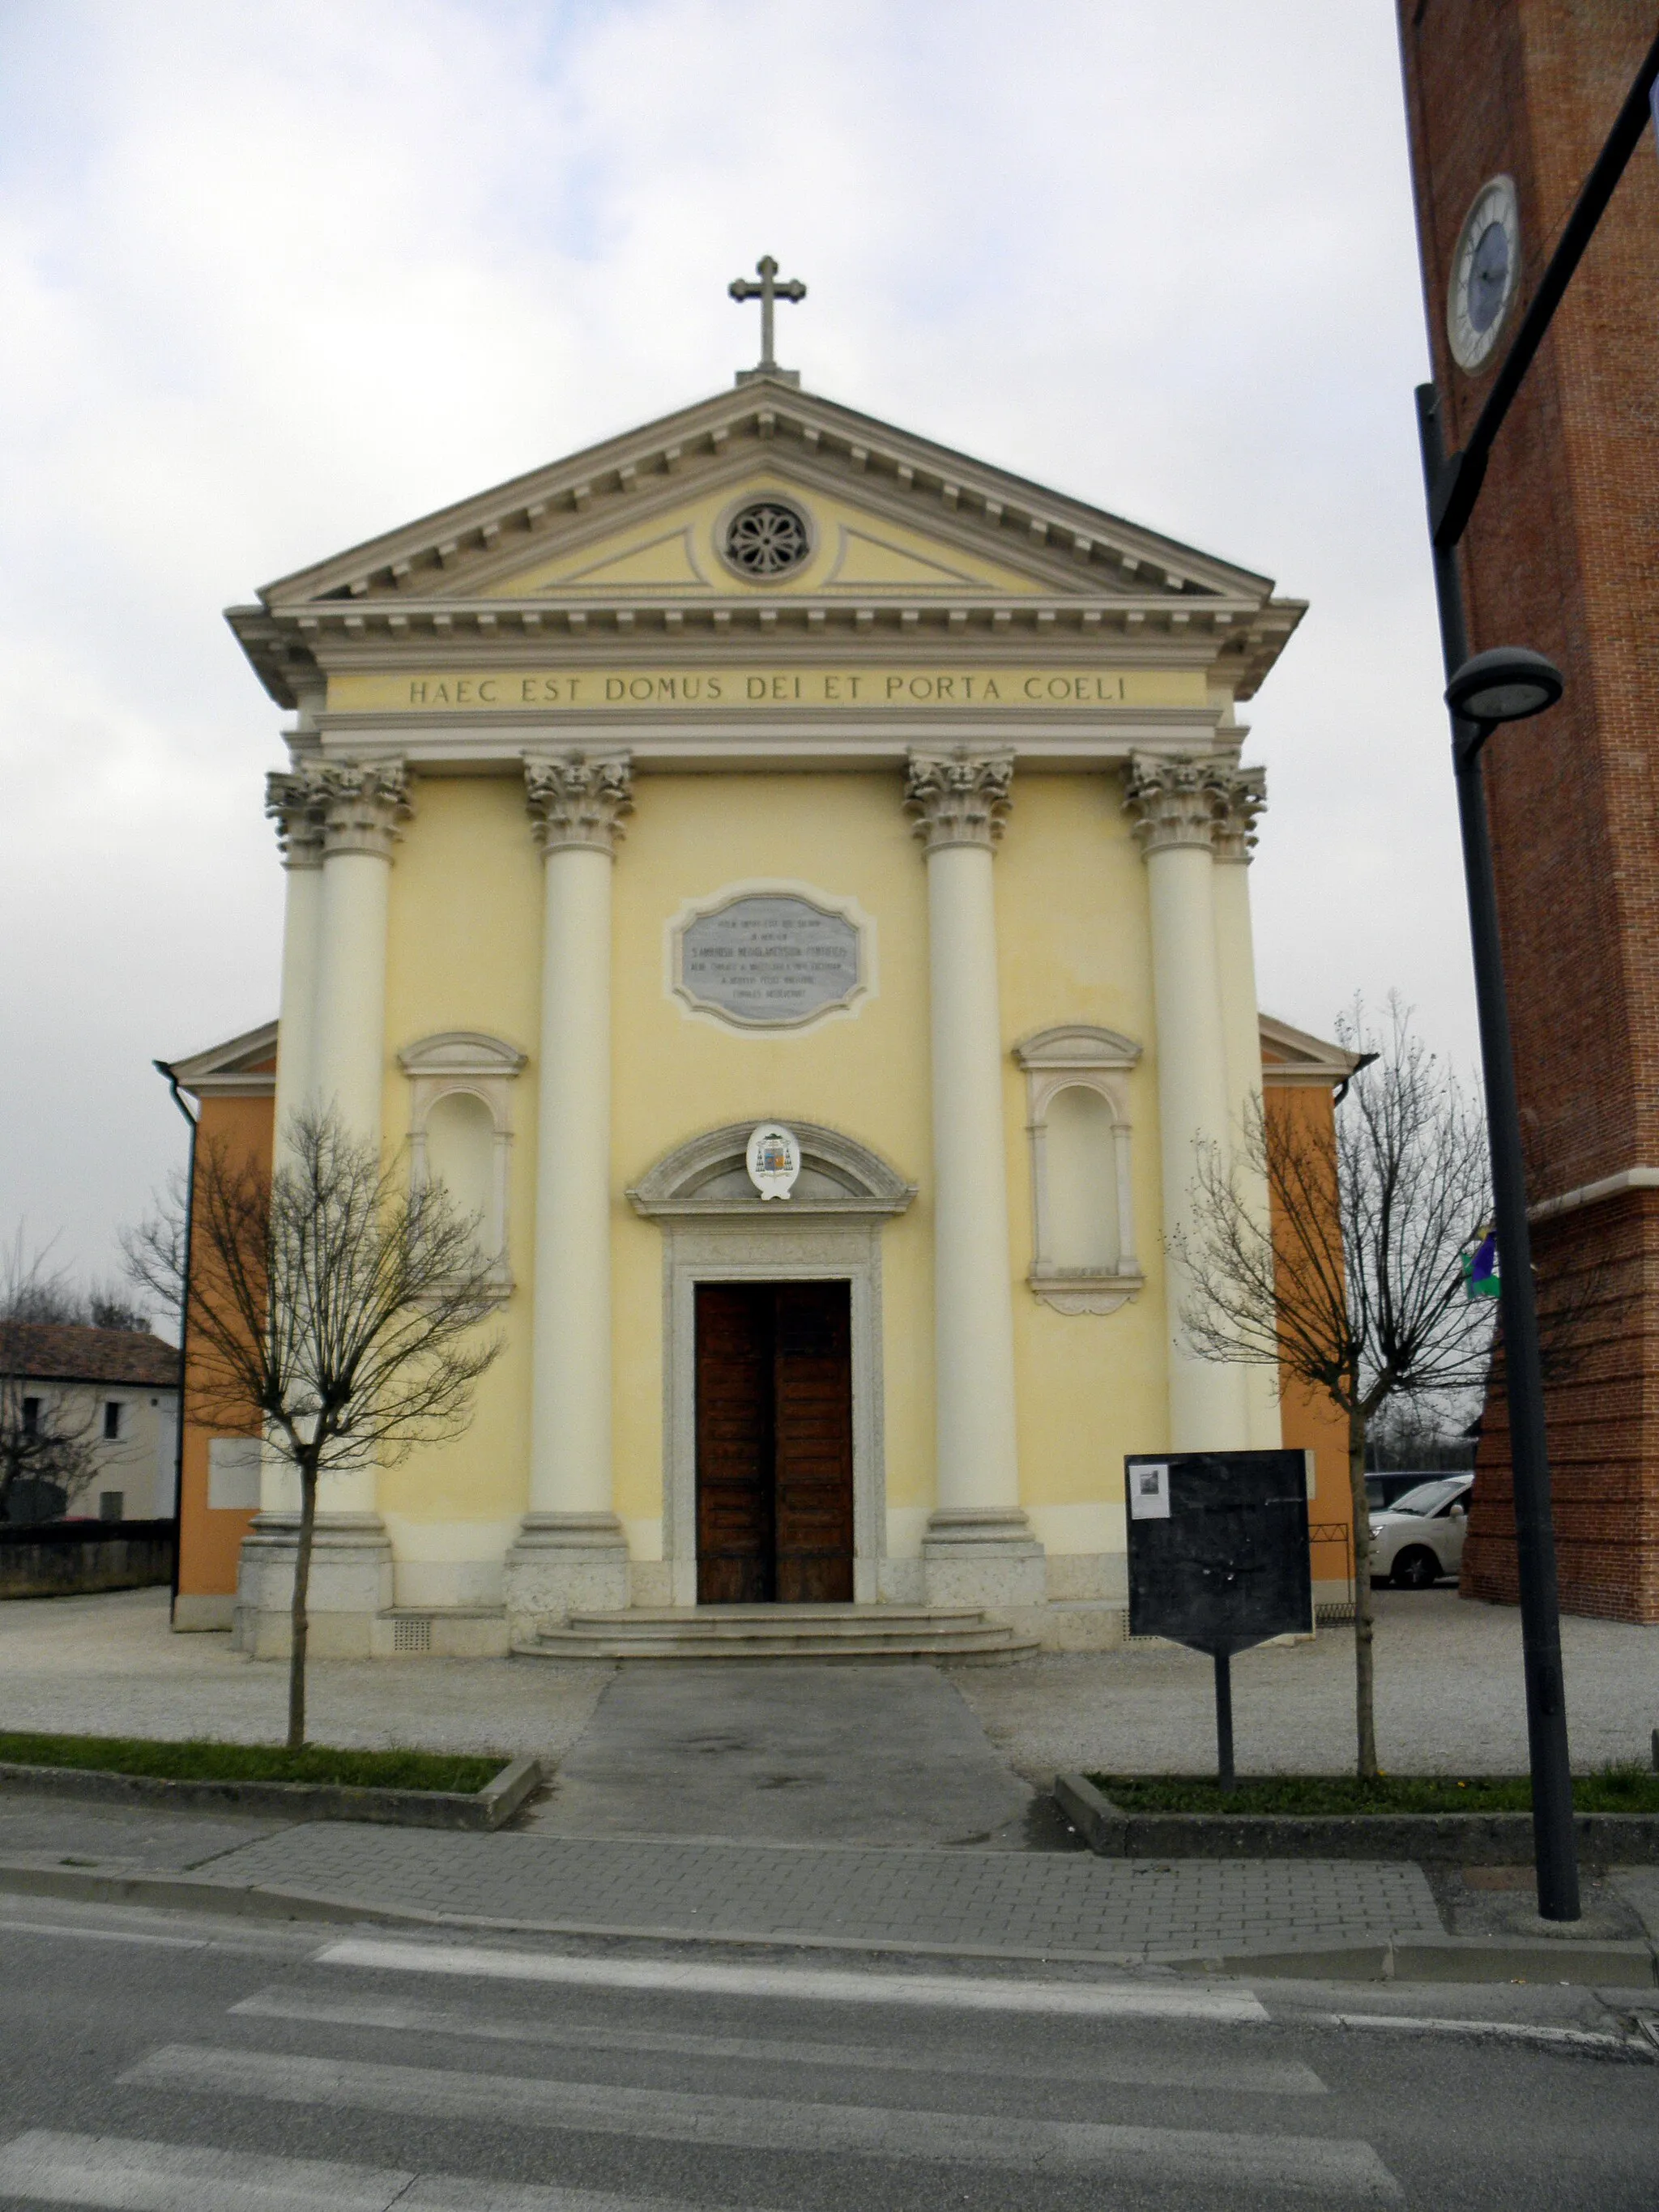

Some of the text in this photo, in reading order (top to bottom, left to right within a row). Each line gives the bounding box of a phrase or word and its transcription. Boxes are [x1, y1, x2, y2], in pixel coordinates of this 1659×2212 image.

[409, 676, 1127, 704] HAEC EST DOMUS DEI ET PORTA COELI
